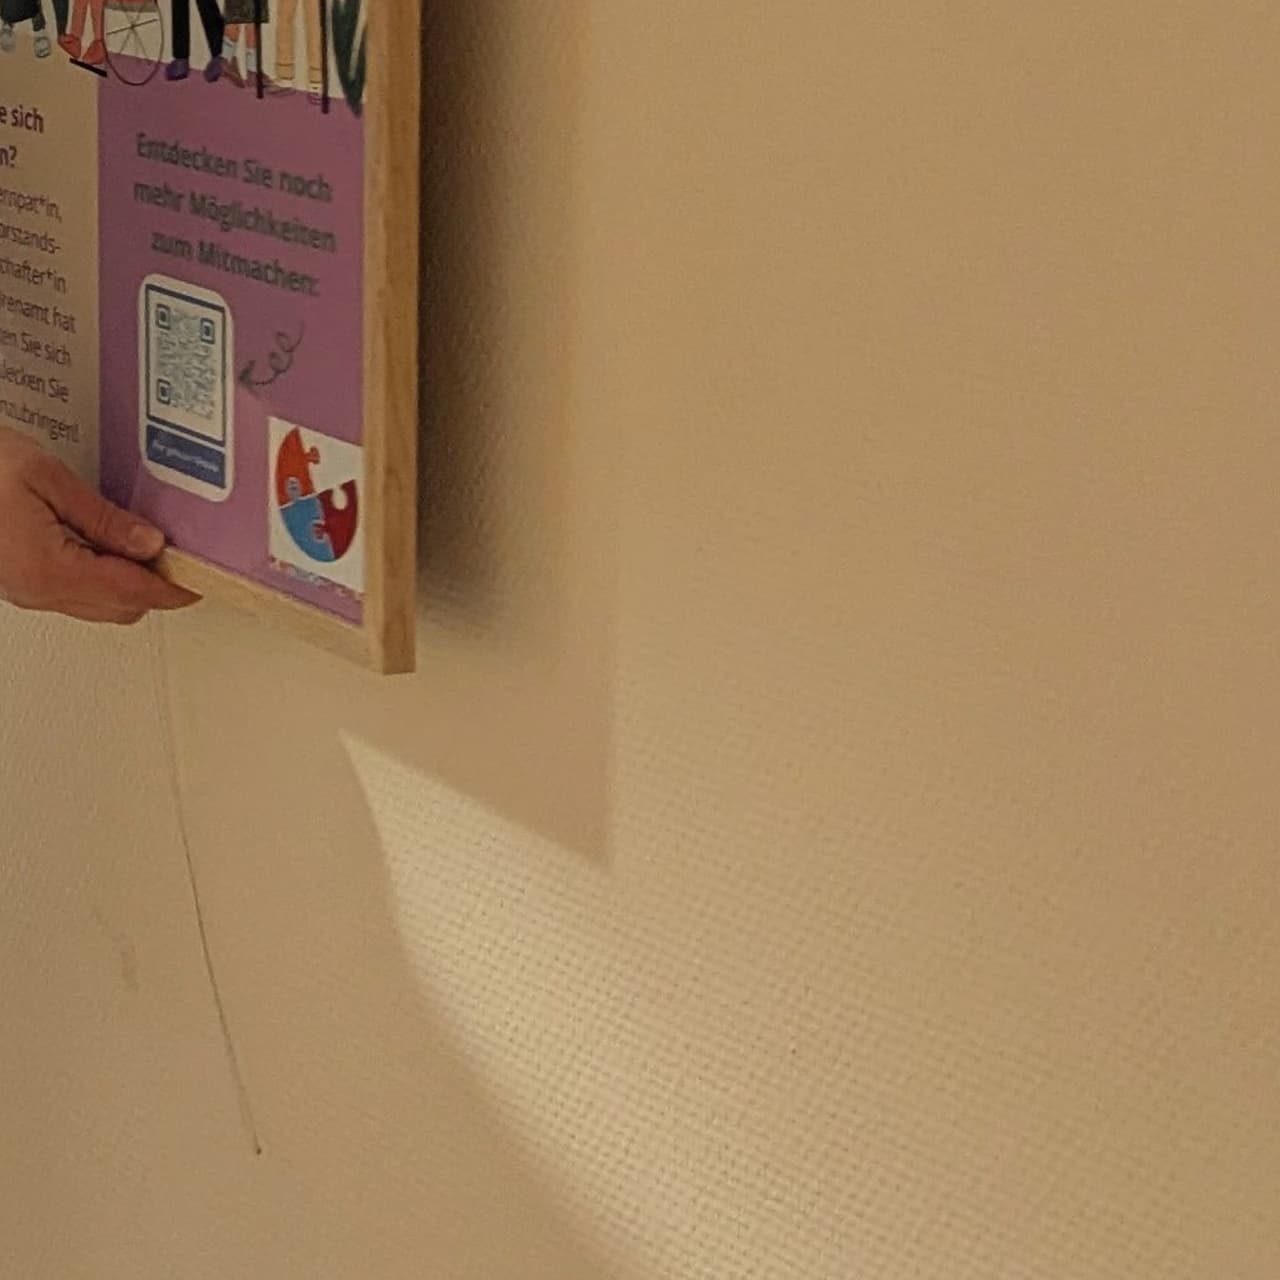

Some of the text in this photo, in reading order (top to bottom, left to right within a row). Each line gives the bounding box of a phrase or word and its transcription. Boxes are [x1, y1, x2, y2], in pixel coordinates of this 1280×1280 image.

[11, 104, 44, 134] sich
[137, 132, 333, 203] Entdecken Sie noch
[134, 181, 337, 254] mehr Möglichkeiten
[151, 231, 193, 261] zum
[20, 331, 41, 358] Sie
[44, 340, 72, 367] sich
[48, 376, 71, 404] Sie
